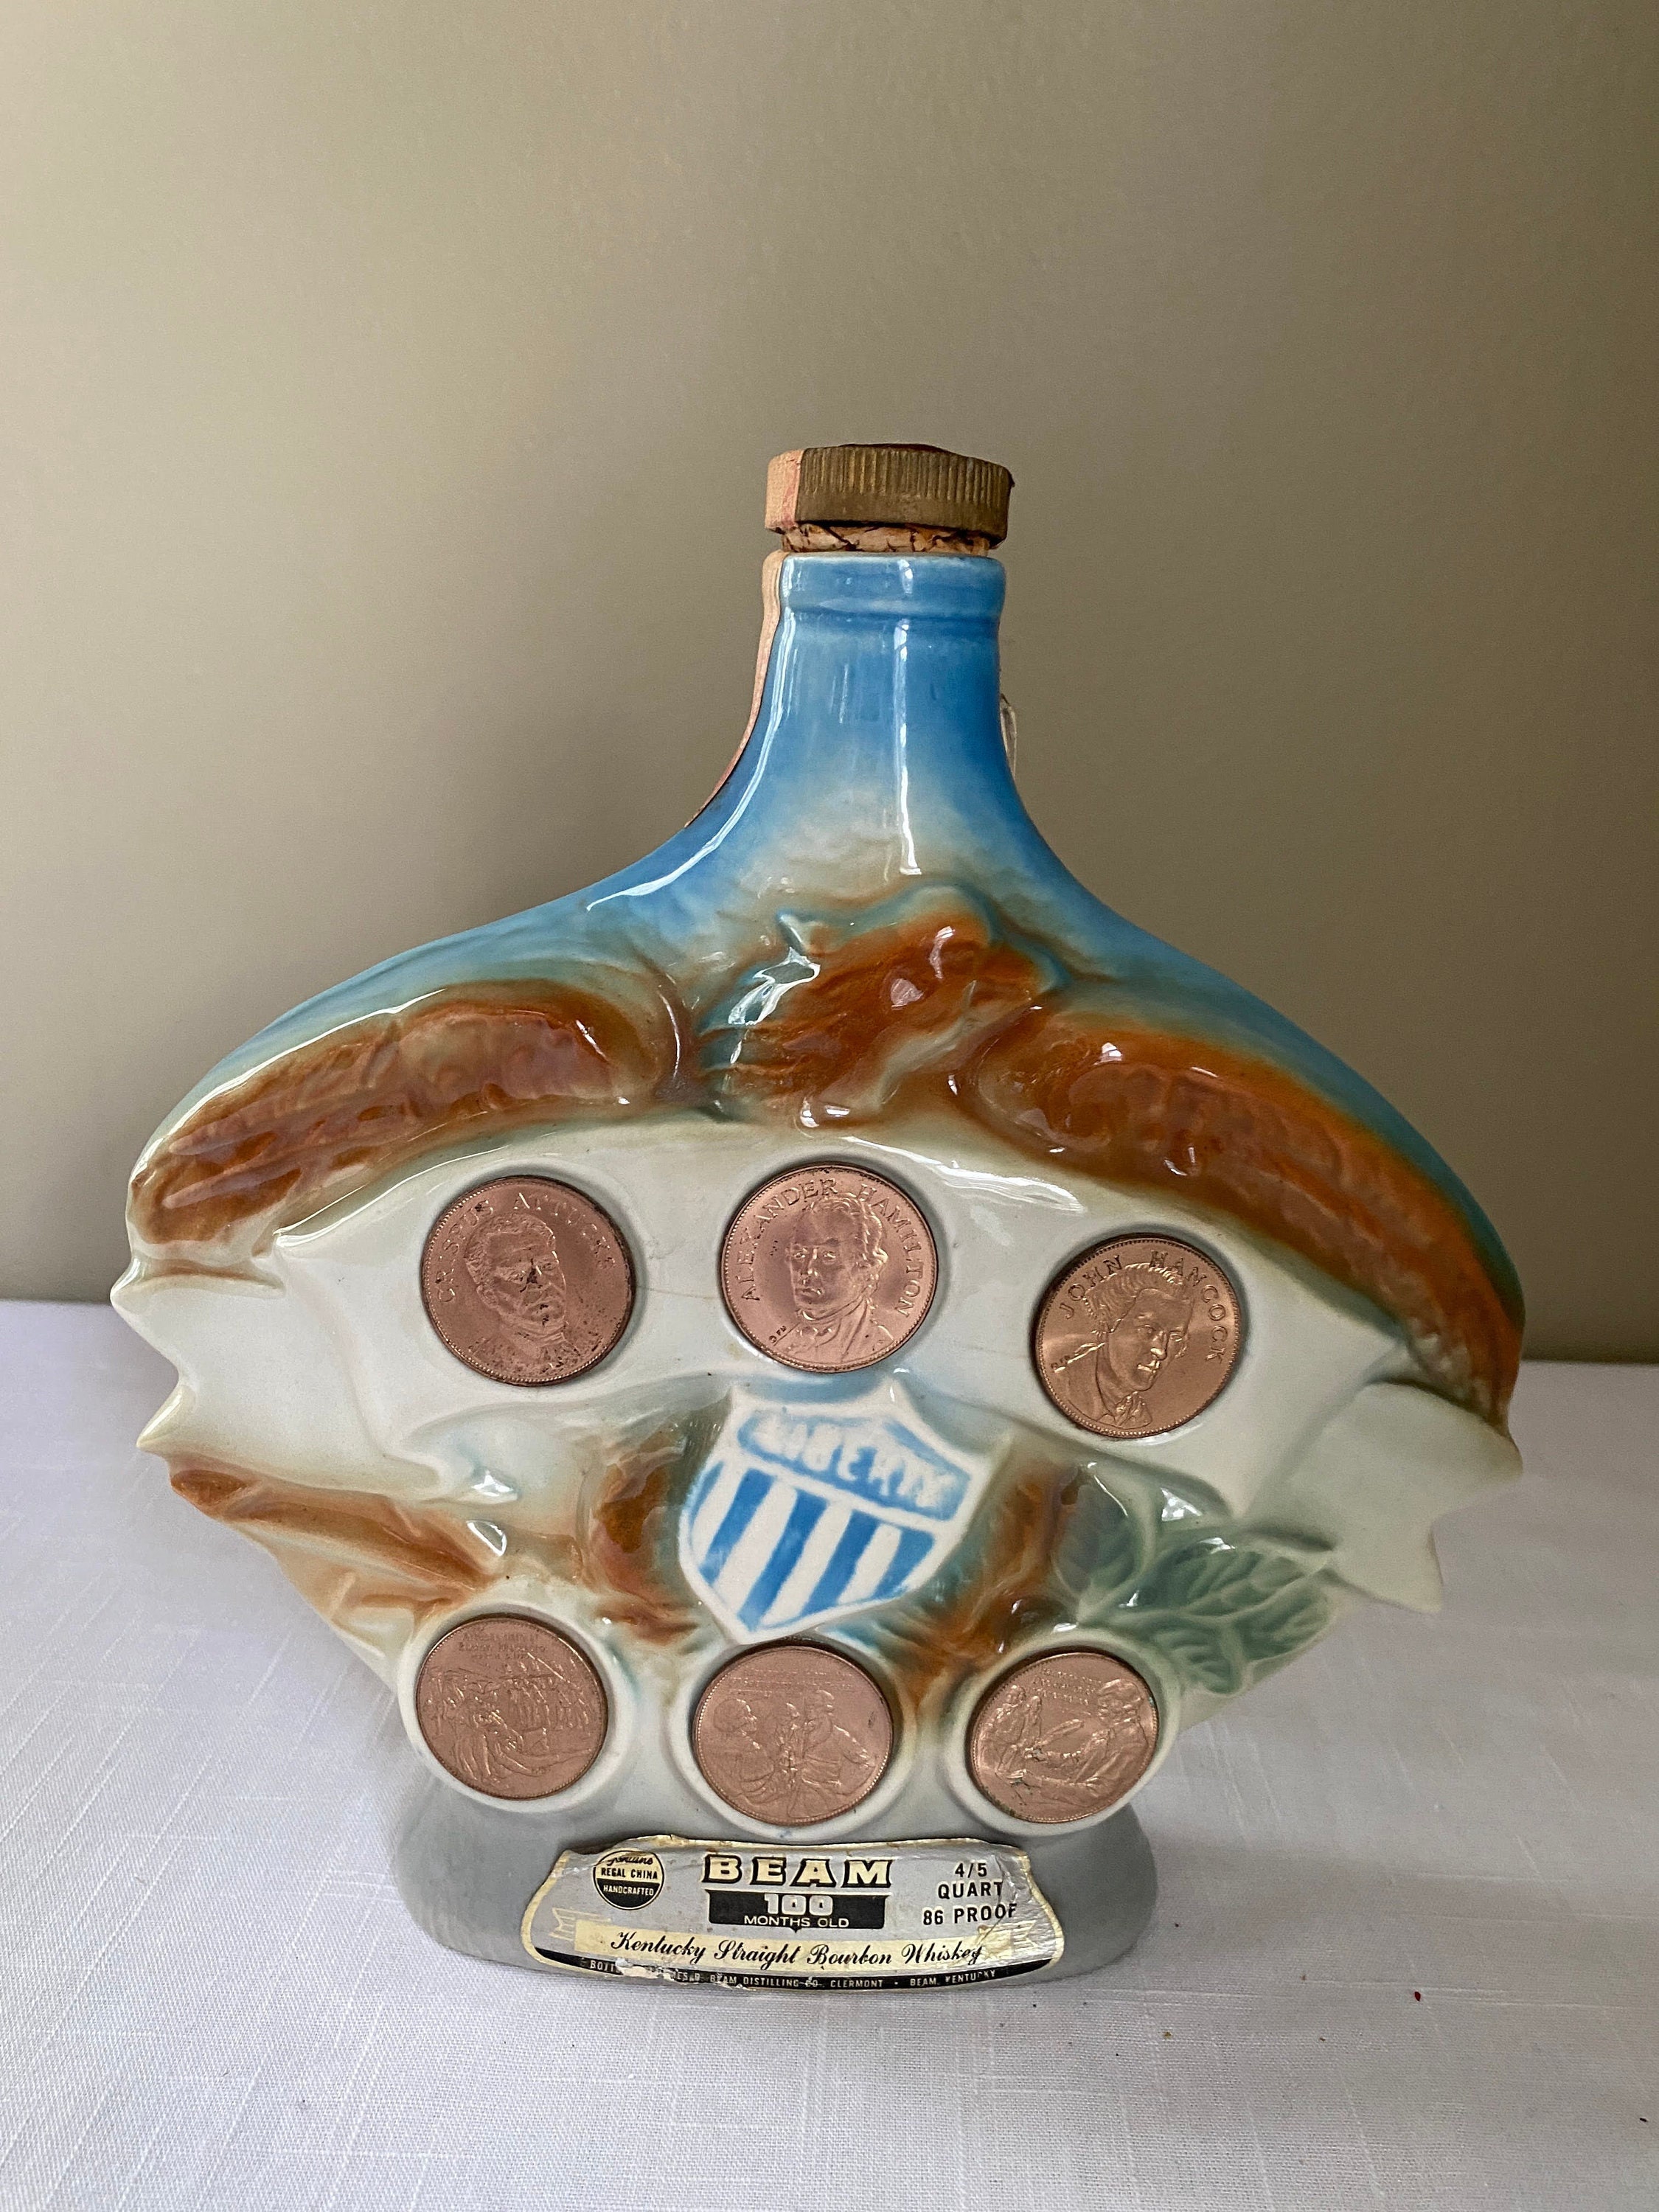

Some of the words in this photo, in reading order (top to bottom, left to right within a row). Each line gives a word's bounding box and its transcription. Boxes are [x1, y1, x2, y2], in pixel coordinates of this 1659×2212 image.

[735, 1178, 838, 1301] ALEXANDER
[855, 1183, 924, 1318] HAMILTON
[1059, 1253, 1123, 1320] JOHN
[1149, 1250, 1228, 1364] HANCOCK
[600, 1867, 627, 1878] REGAL
[630, 1868, 658, 1880] CHINA
[700, 1853, 894, 1888] BEAM
[954, 1863, 988, 1879] 4/5
[603, 1885, 654, 1896] HANDCRAFTED
[937, 1881, 1004, 1900] QUART
[764, 1892, 834, 1916] 100
[922, 1909, 944, 1926] 86
[953, 1903, 1018, 1924] PROOF
[743, 1915, 811, 1927] MONTHS
[817, 1917, 849, 1928] OLD
[610, 1931, 707, 1964] Kentucky
[713, 1938, 802, 1971] Straight
[806, 1943, 893, 1966] Bourbon
[900, 1941, 983, 1966] Whiskey
[742, 1977, 799, 1988] DISTILLING
[830, 1979, 884, 1989] CLERMONT
